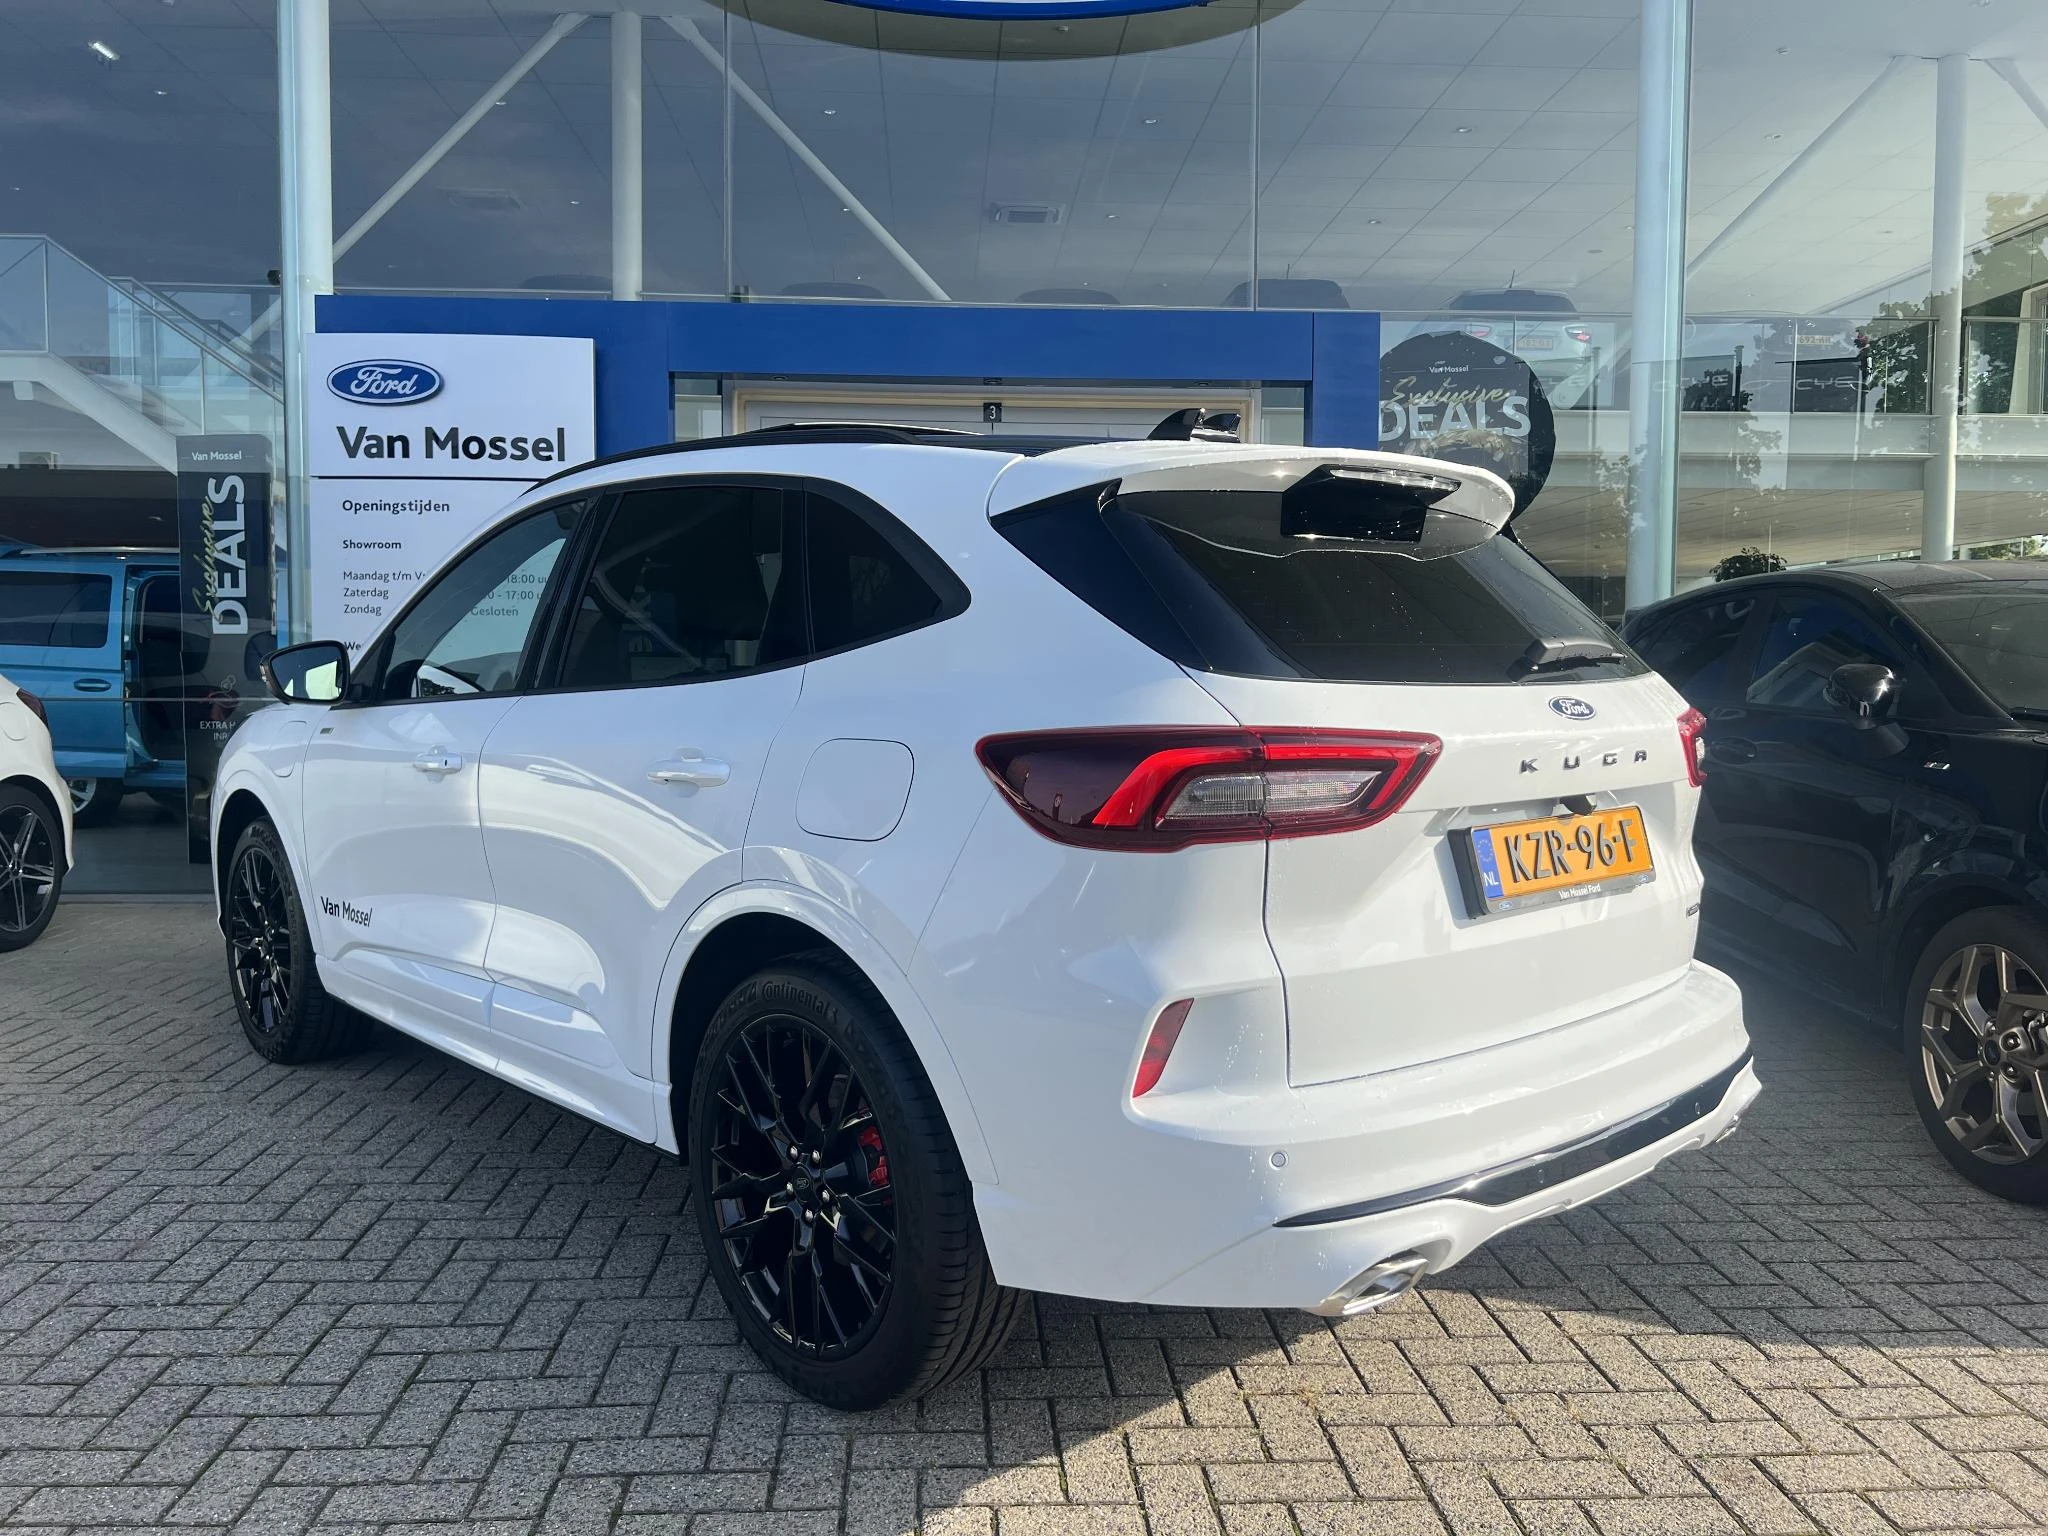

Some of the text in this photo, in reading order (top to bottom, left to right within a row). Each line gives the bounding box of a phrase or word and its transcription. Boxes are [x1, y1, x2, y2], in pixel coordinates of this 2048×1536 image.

[1444, 364, 1469, 373] Mossel
[350, 365, 417, 396] Ford
[1378, 395, 1531, 442] DEALS
[336, 426, 565, 462] Van Mossel
[191, 450, 242, 461] Van Mossel
[342, 499, 450, 515] Openingstijden
[342, 539, 402, 550] Showroom
[207, 474, 248, 635] DEALS
[343, 570, 390, 583] Maandag
[392, 571, 412, 581] t/m
[343, 587, 389, 600] Zaterdag
[506, 590, 534, 600] 17:00
[343, 603, 382, 616] Zondag
[470, 605, 519, 616] Gesloten
[200, 721, 227, 730] EXTRA
[1519, 749, 1648, 774] KUGA
[1503, 818, 1638, 884] KZR-96-F
[1483, 871, 1499, 887] NL
[1558, 883, 1601, 899] Van Mossel Ford
[320, 895, 373, 928] Van Mossel
[761, 979, 830, 1017] Continental
